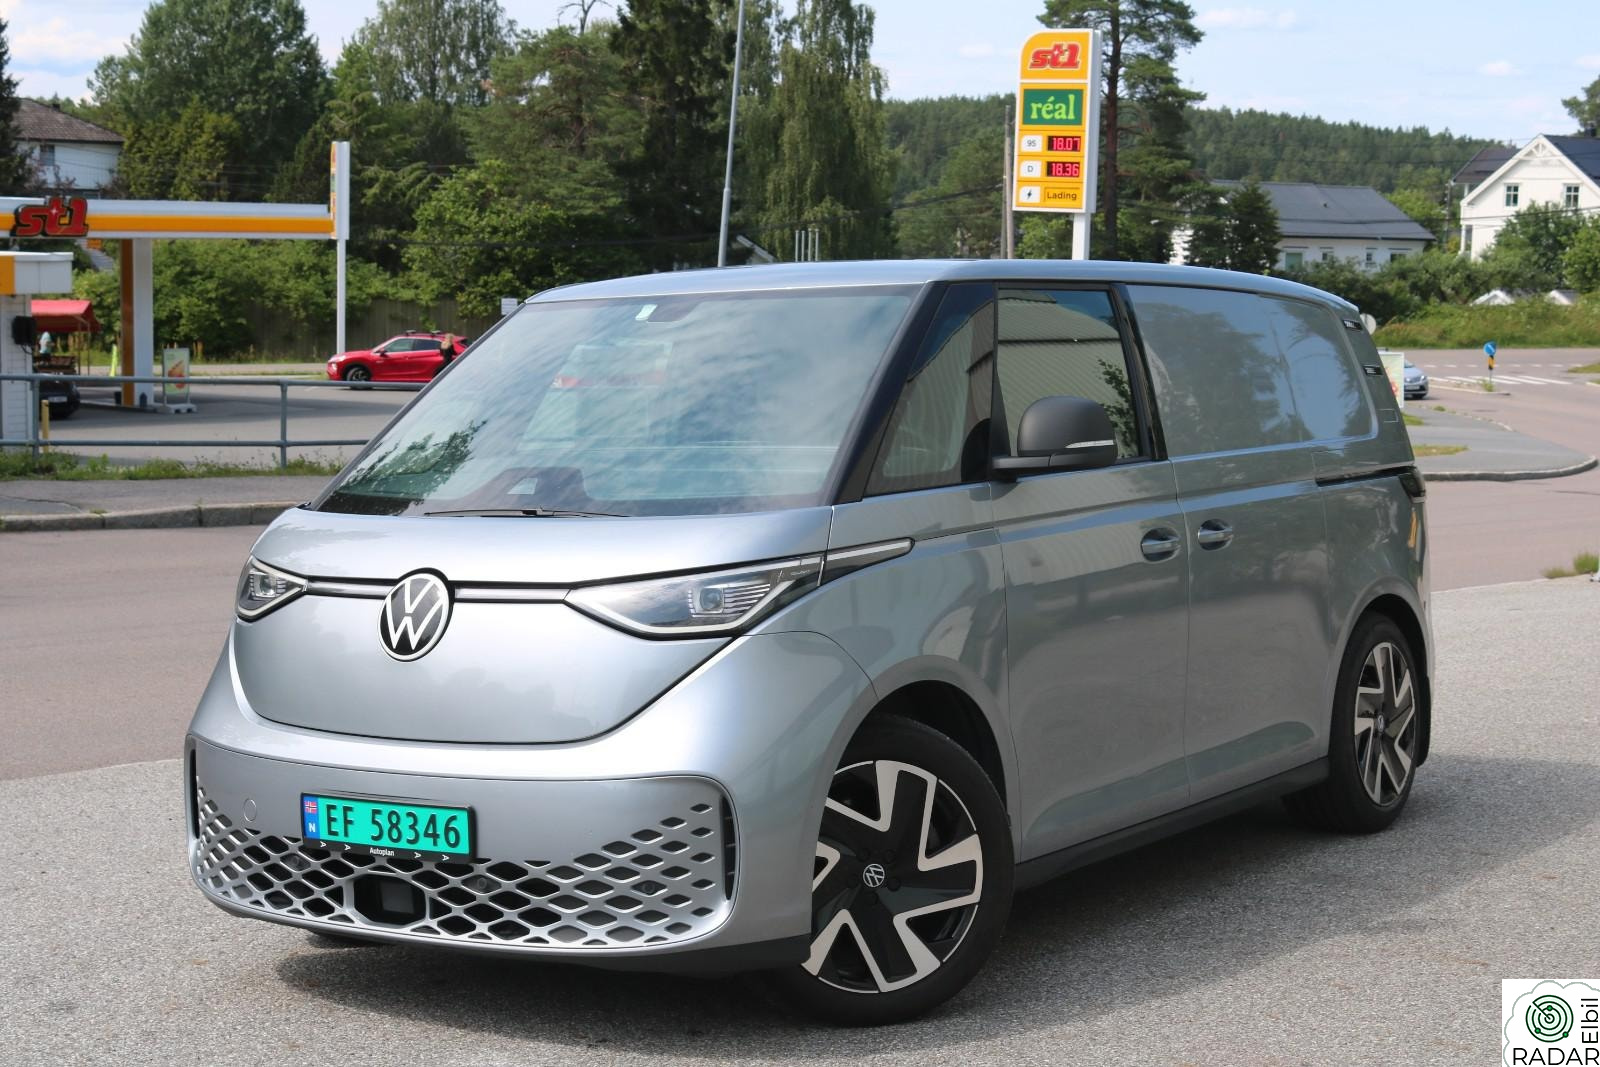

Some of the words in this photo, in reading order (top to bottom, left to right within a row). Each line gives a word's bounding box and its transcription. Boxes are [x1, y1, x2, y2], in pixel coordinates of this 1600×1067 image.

[1028, 43, 1080, 69] st1
[1030, 94, 1076, 120] réal
[1026, 139, 1037, 147] 95
[1052, 137, 1081, 151] 18.07
[1027, 165, 1034, 173] D
[1051, 163, 1080, 176] 18.36
[1046, 191, 1078, 201] Lading
[14, 196, 89, 237] st1
[308, 823, 316, 833] N
[325, 804, 355, 838] EF
[370, 808, 461, 849] 58346
[369, 847, 395, 857] Autoplan
